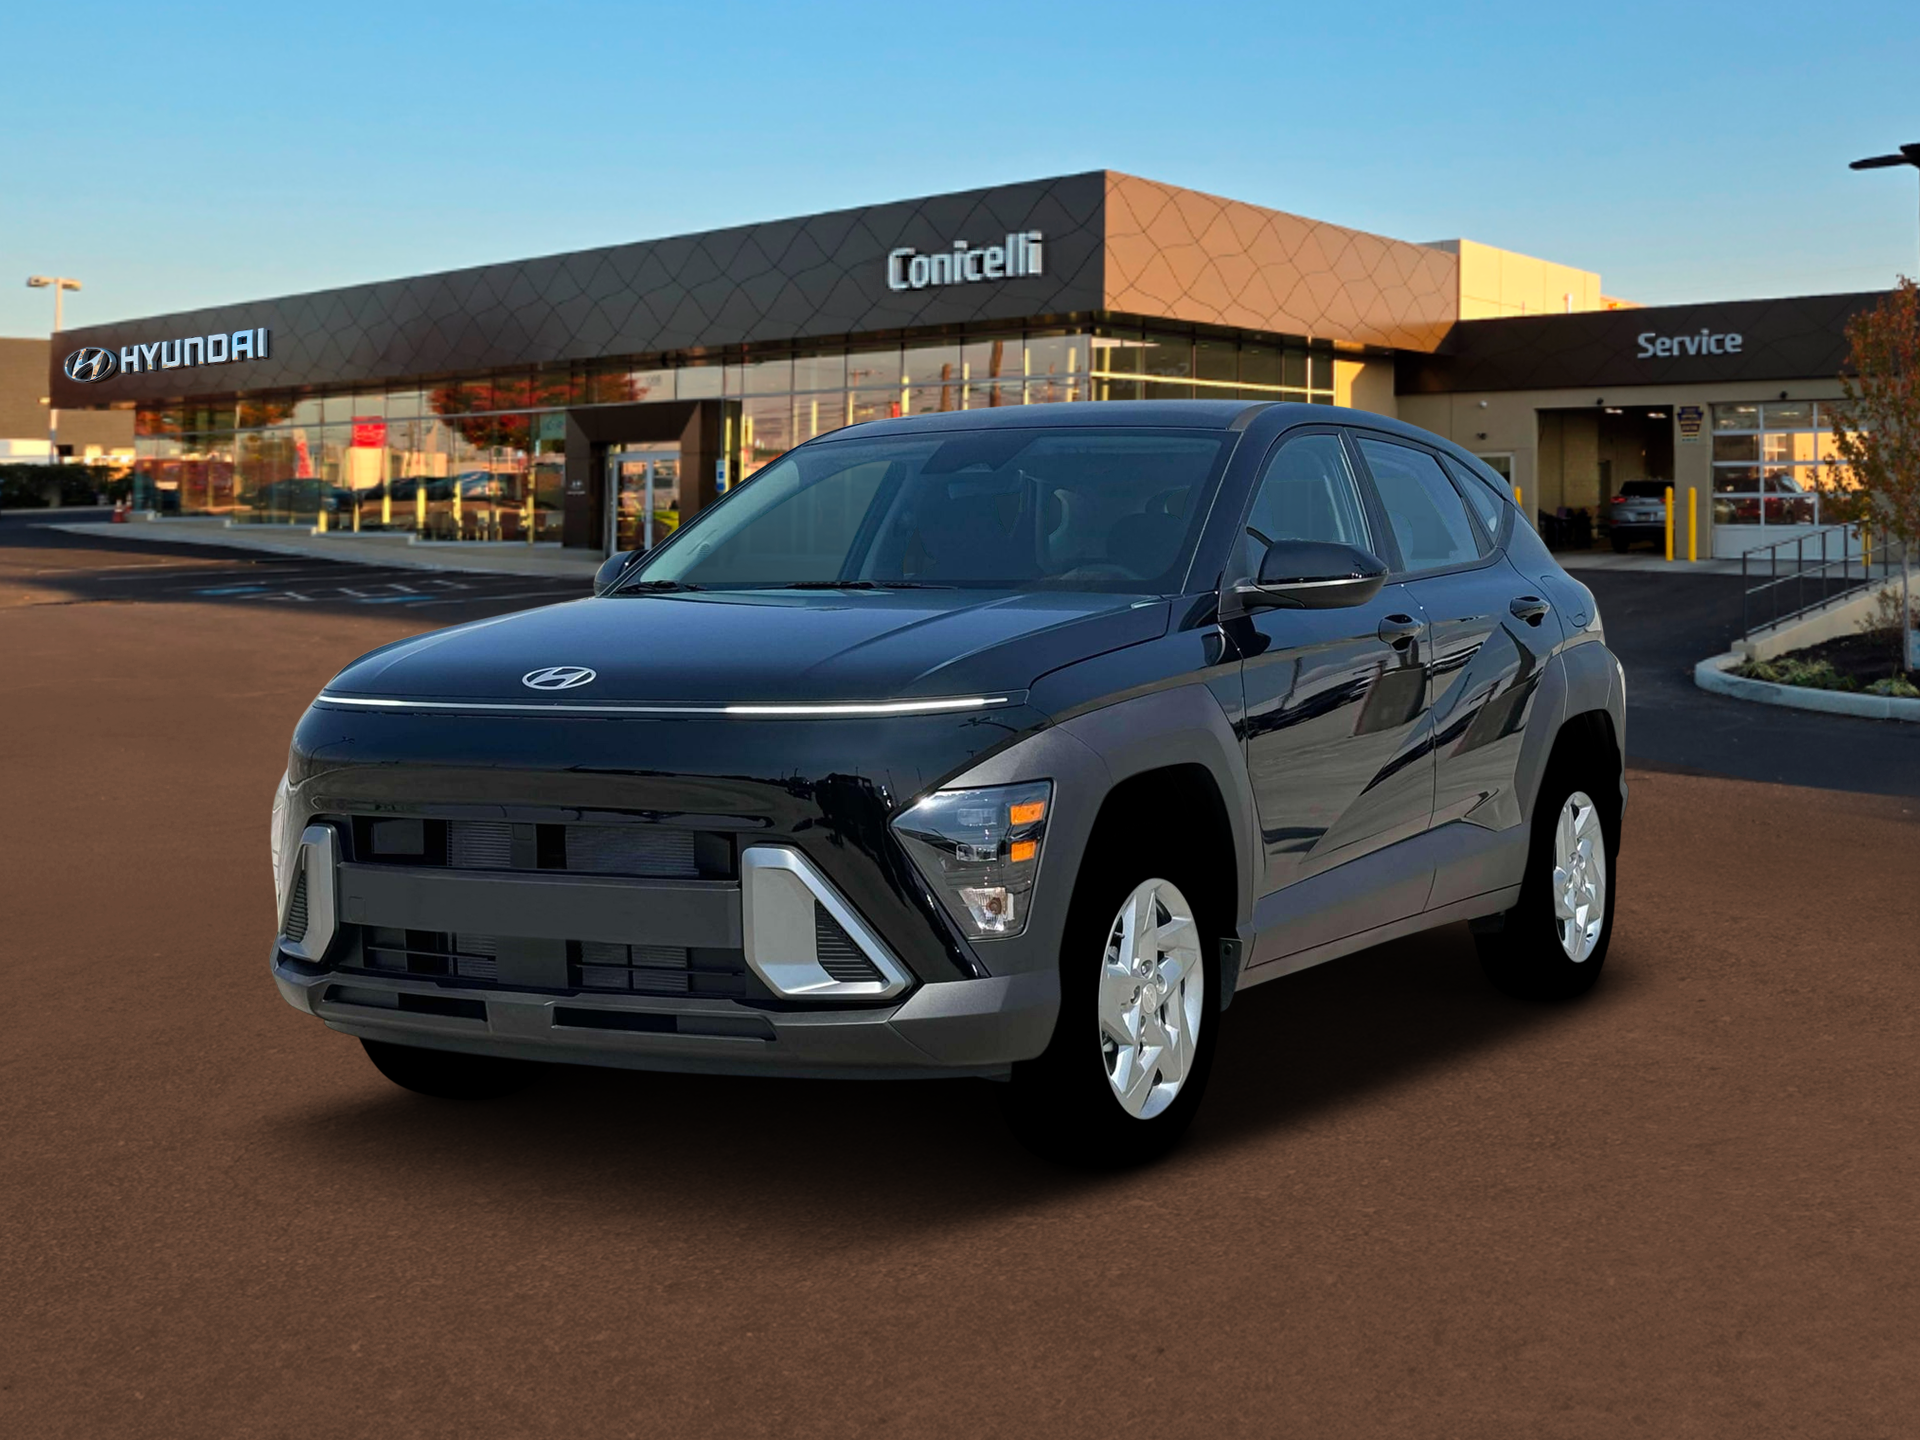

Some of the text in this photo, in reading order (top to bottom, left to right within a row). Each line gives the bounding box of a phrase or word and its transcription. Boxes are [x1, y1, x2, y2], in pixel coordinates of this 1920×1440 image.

[888, 230, 1043, 291] Conicelli
[120, 327, 268, 373] HYUNDAI
[1637, 328, 1742, 359] Service
